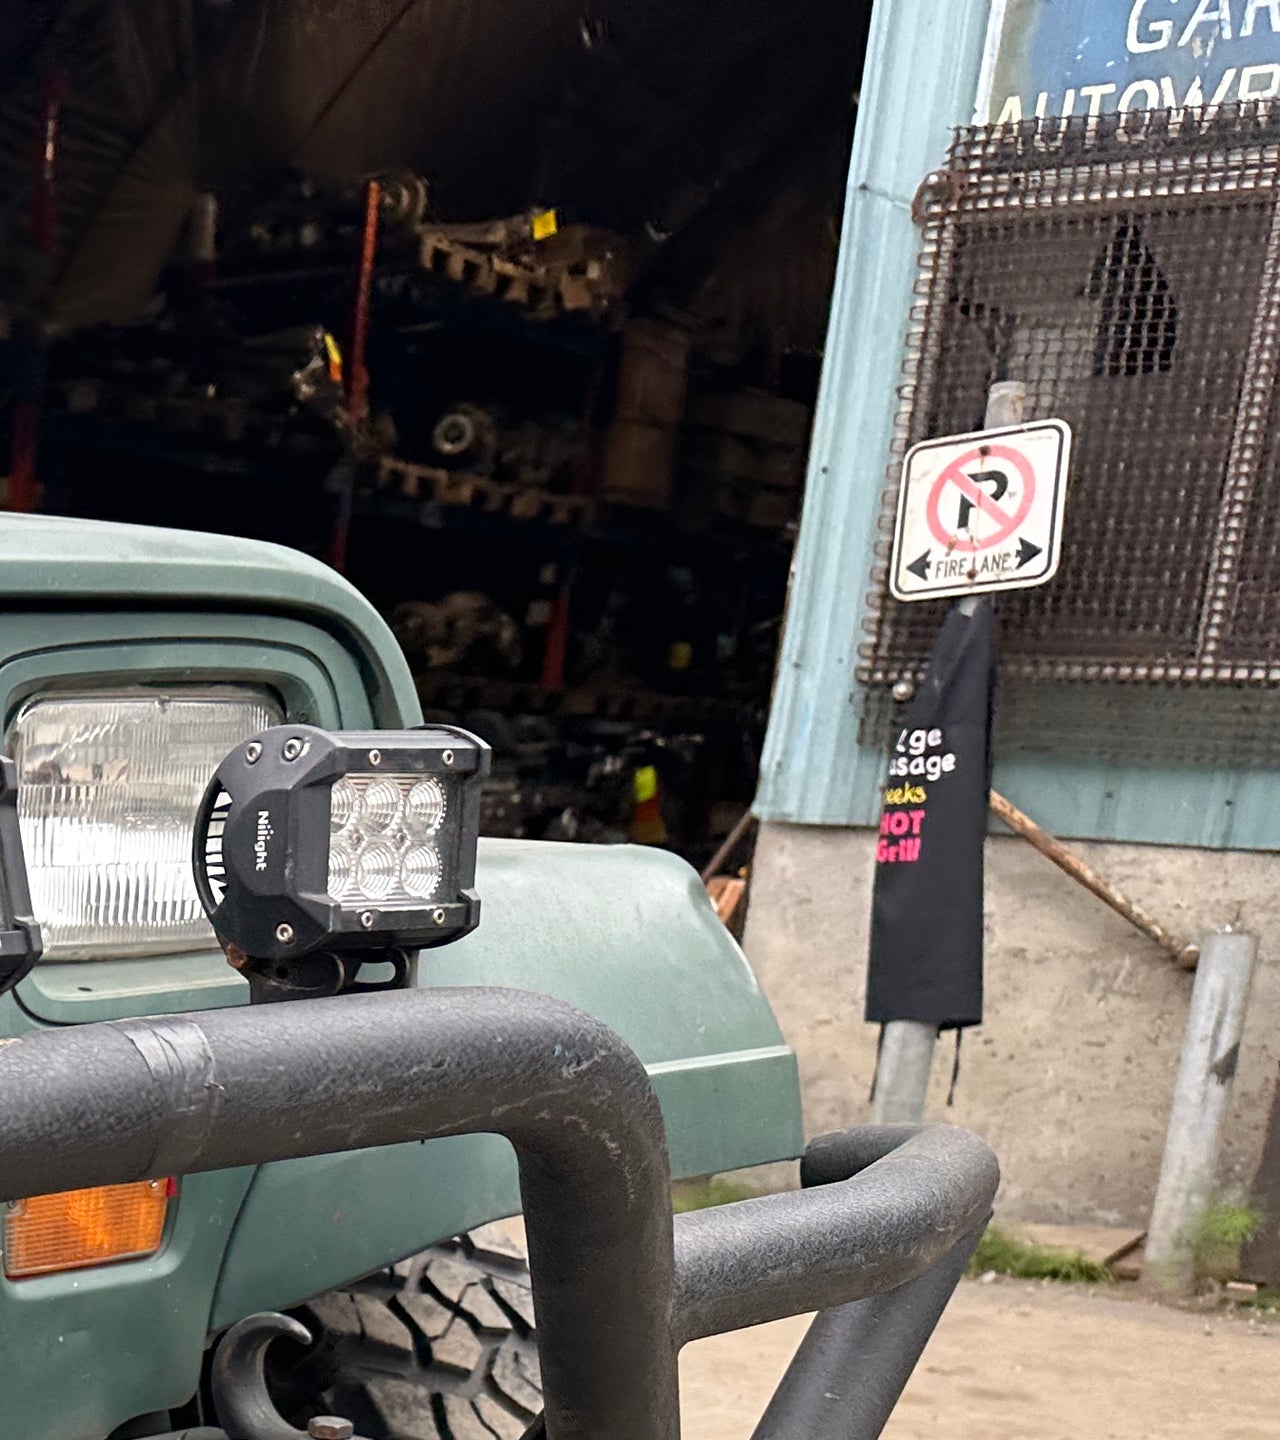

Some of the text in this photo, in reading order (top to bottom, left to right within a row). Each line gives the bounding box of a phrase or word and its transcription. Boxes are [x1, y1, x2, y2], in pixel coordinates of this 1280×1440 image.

[935, 551, 1013, 579] FIRE LANE
[254, 810, 275, 872] Nilight
